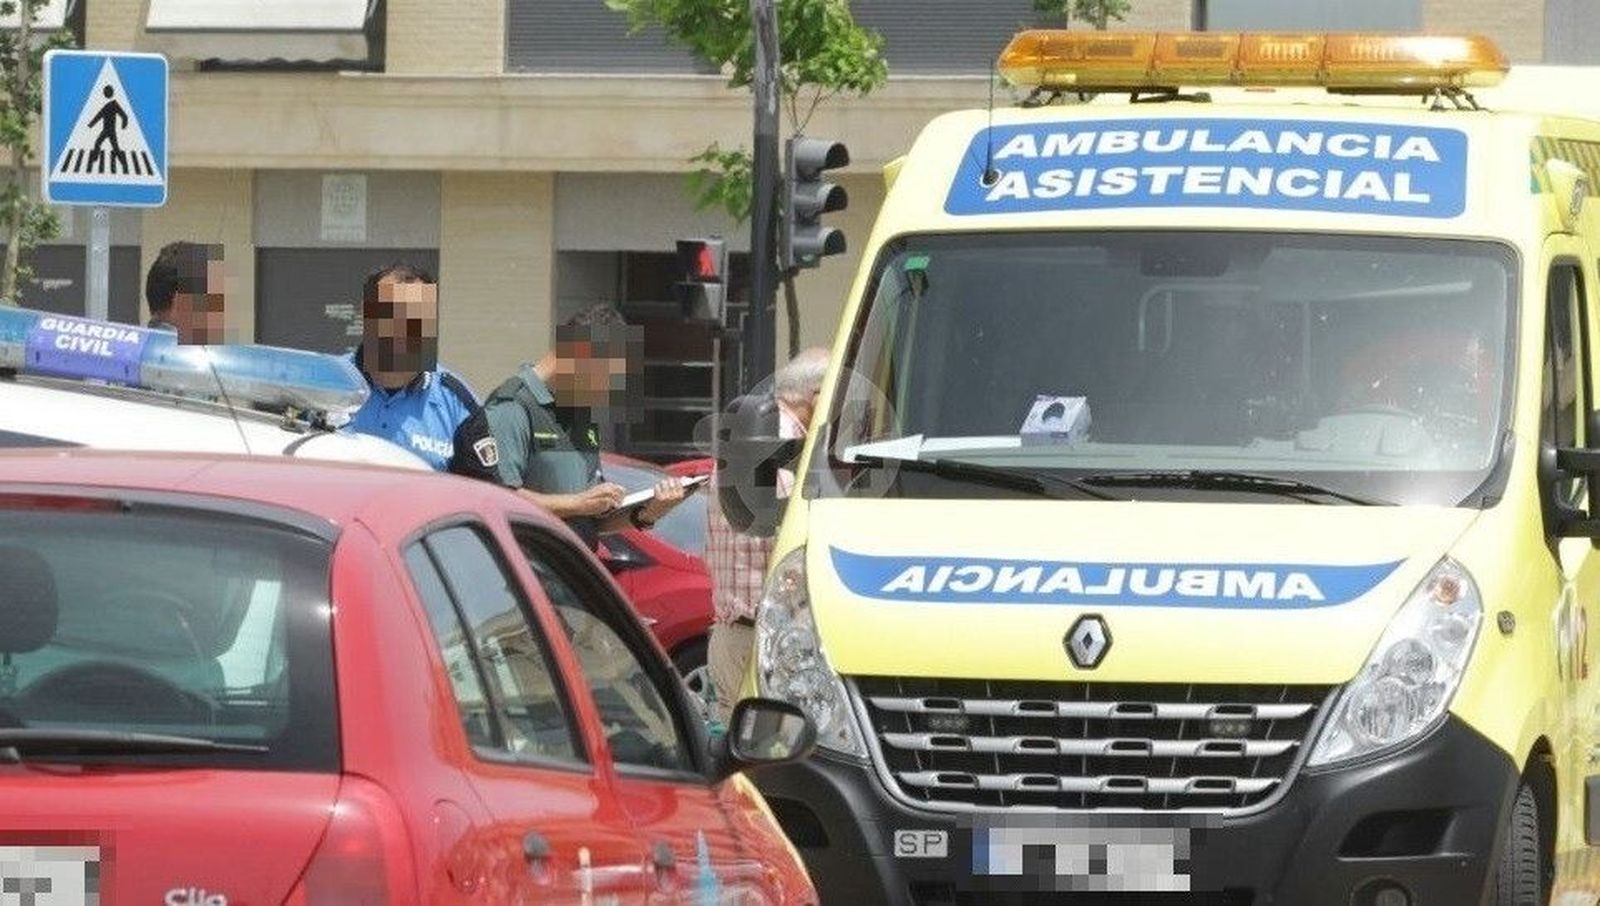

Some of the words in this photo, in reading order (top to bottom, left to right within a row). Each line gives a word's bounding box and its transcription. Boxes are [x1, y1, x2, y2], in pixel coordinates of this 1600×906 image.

[993, 129, 1441, 163] AMBULANCIA
[985, 165, 1431, 204] ASISTENCIAL
[41, 318, 139, 344] GUARDIA
[55, 334, 112, 357] CIVIL
[900, 833, 942, 854] SP
